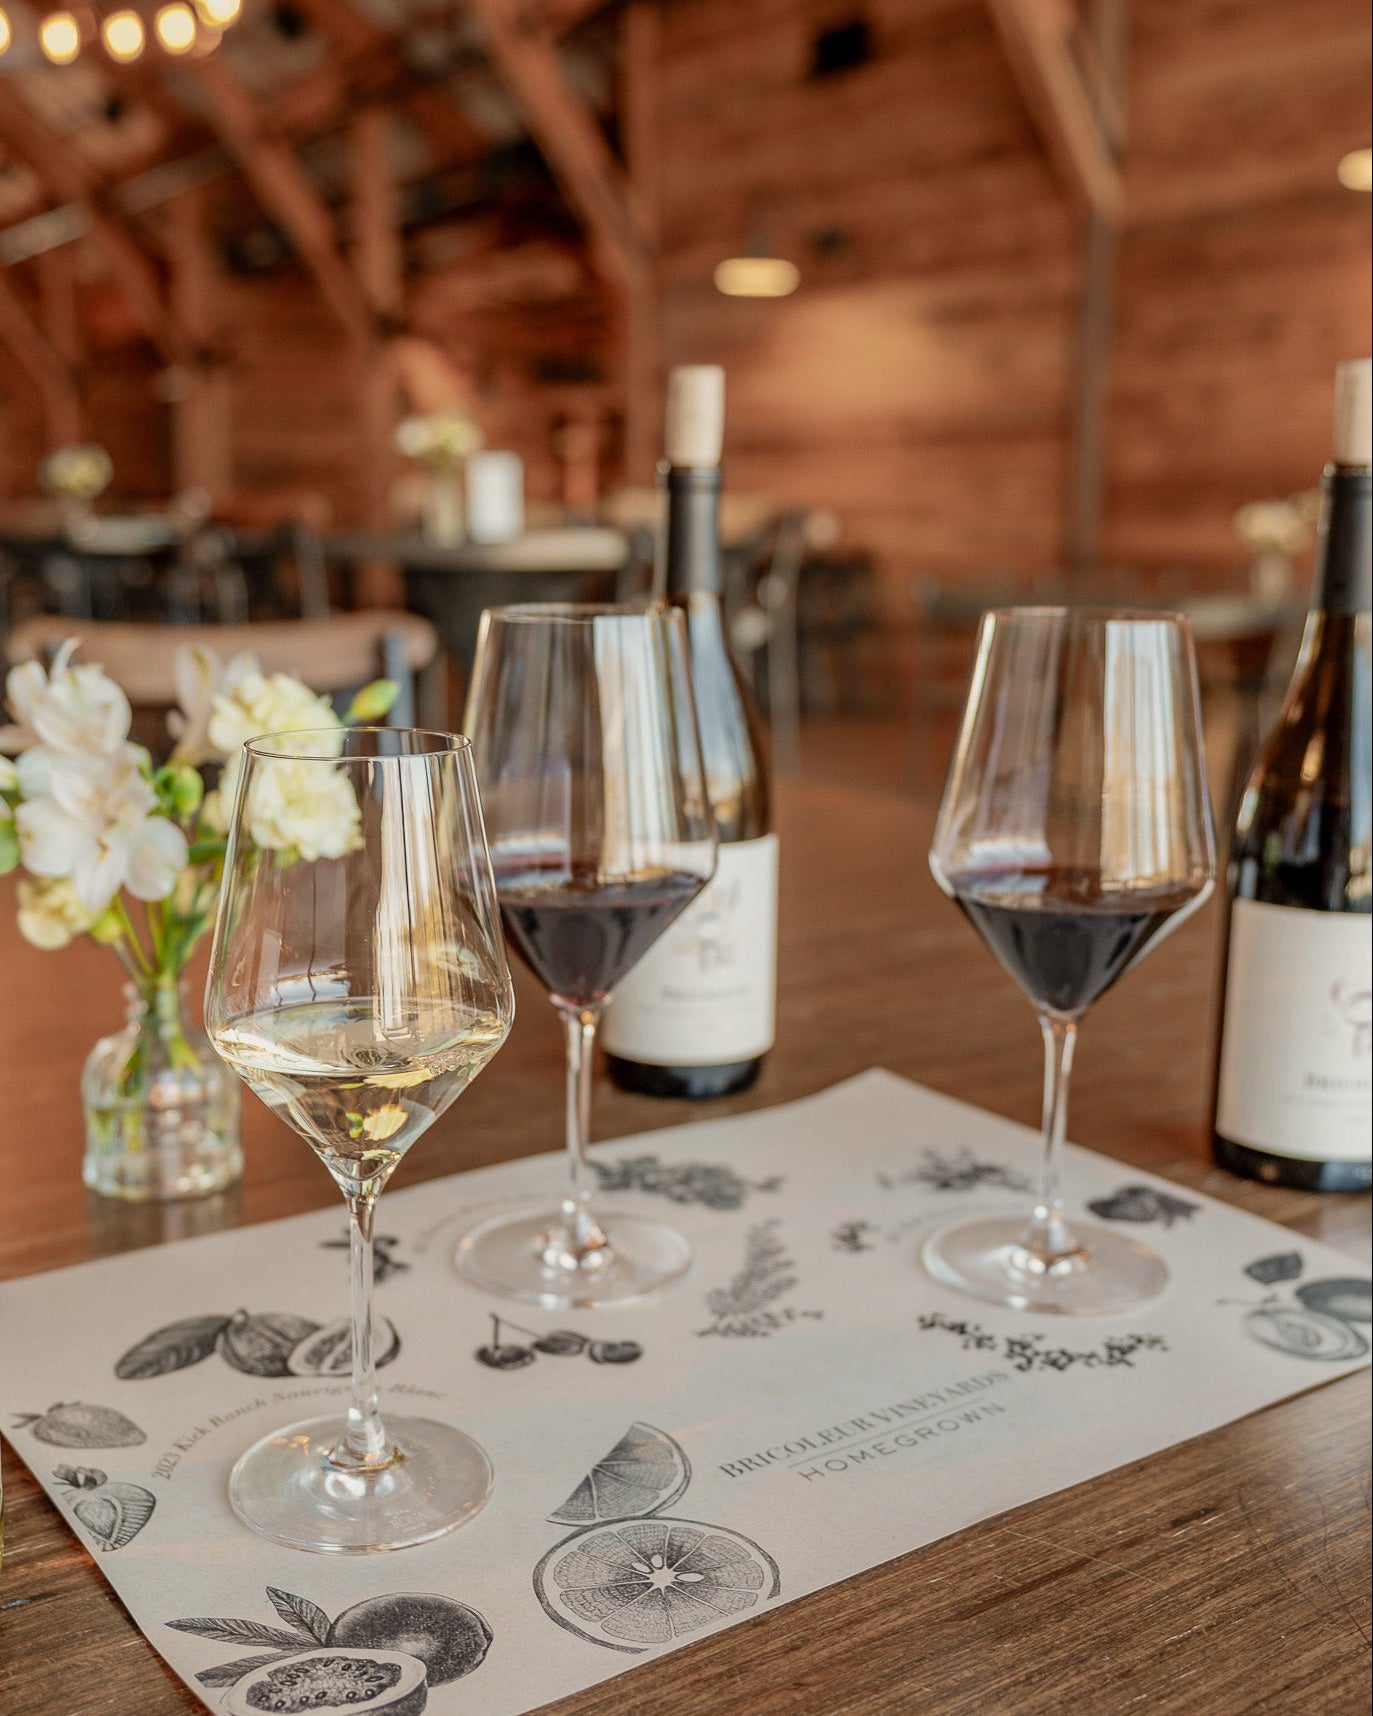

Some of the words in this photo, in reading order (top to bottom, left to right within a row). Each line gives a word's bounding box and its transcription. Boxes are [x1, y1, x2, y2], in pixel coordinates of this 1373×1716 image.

[152, 1451, 181, 1480] 2023
[210, 1398, 268, 1428] Ranch
[719, 1417, 877, 1479] BRICOLEUR
[870, 1370, 1009, 1424] VINEYARDS
[798, 1401, 1007, 1482] HOMEGROWN
